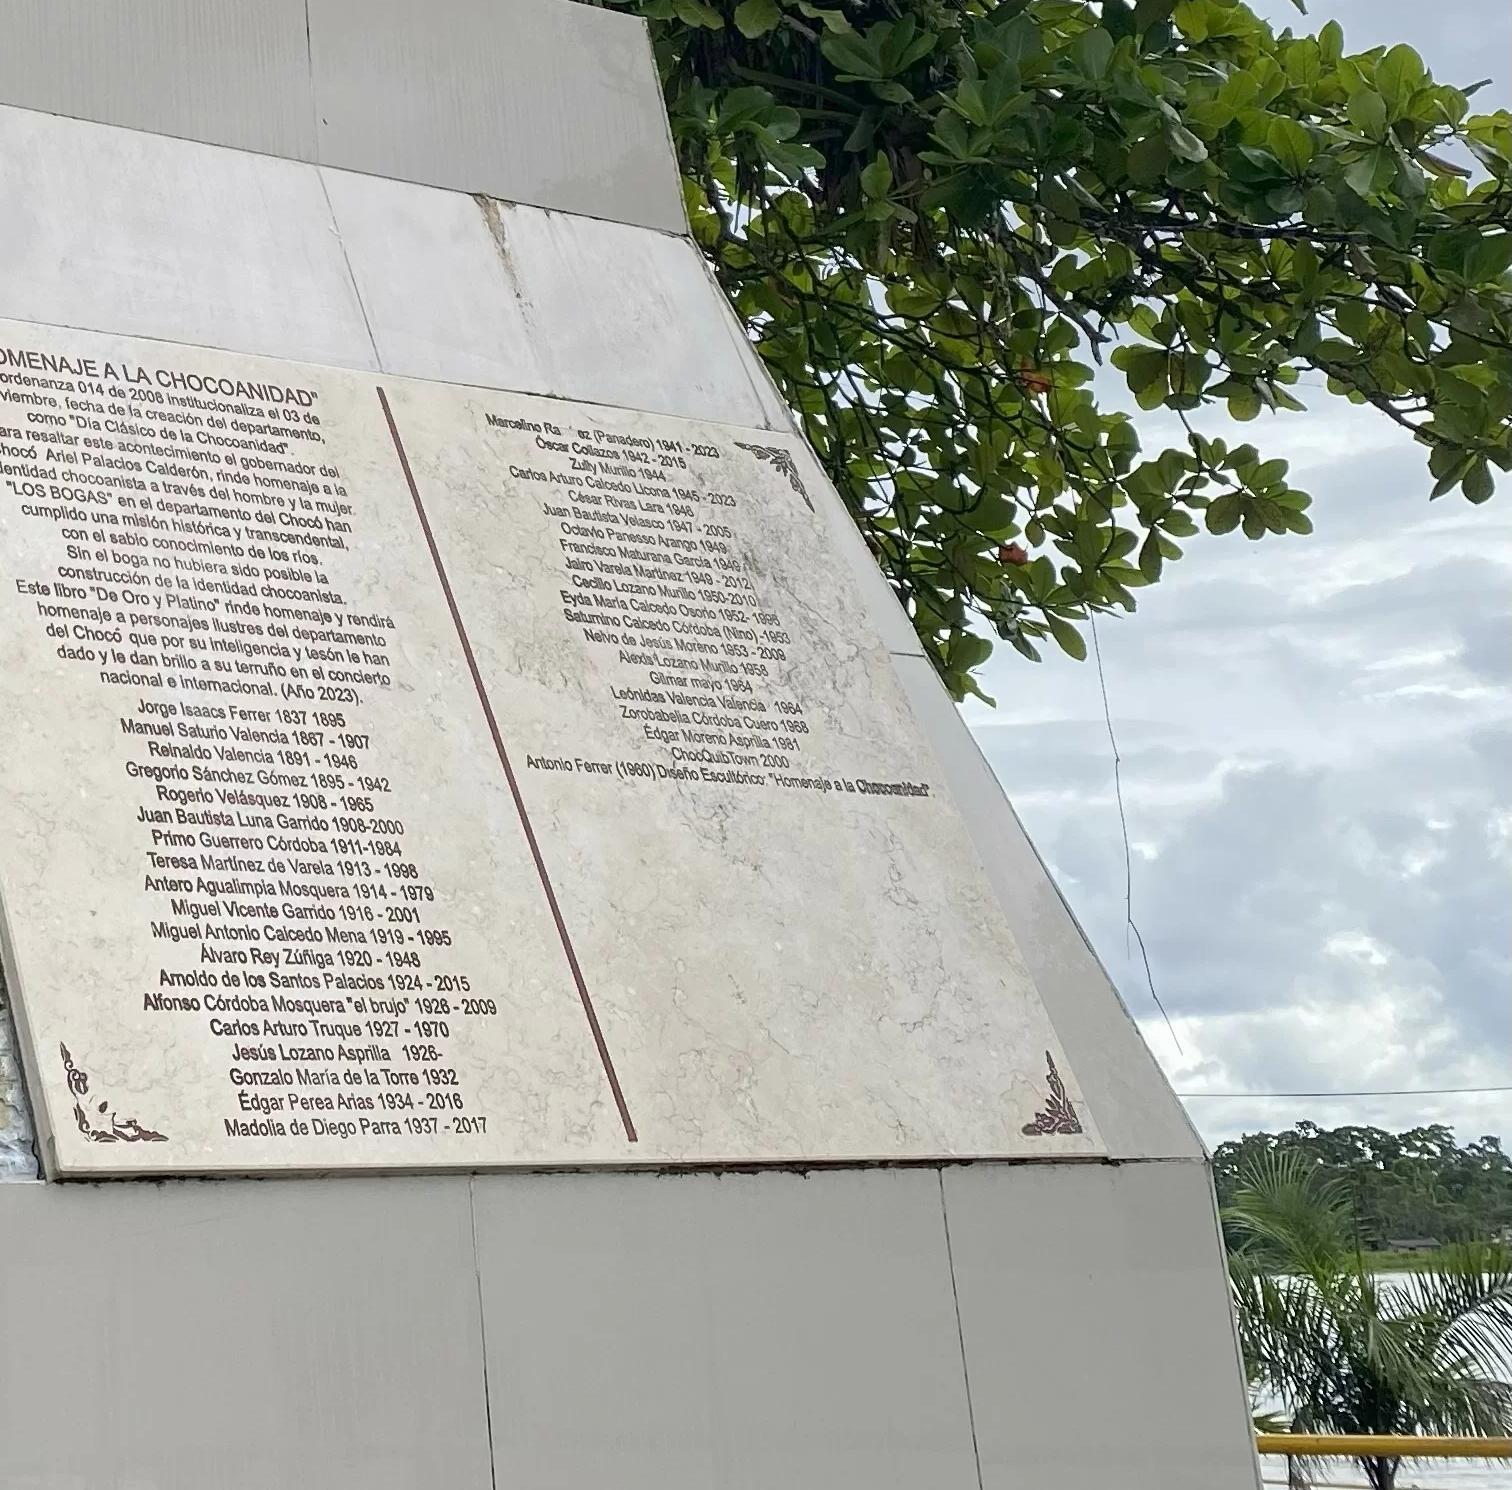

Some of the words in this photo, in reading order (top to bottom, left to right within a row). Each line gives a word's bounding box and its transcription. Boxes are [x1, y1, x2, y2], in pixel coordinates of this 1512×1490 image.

[103, 361, 121, 382] A
[121, 363, 153, 386] LA
[154, 369, 319, 408] CHOCOANIDAD"
[77, 380, 105, 397] 014
[107, 384, 127, 399] de
[127, 387, 165, 405] 2008
[165, 391, 266, 419] institucionaliza
[267, 406, 281, 421] el
[281, 408, 301, 423] 03
[302, 411, 321, 426] de
[64, 396, 106, 415] fecha
[107, 401, 126, 417] de
[125, 403, 143, 420] la
[144, 409, 204, 427] creación
[206, 414, 228, 430] del
[230, 418, 326, 445] departamento,
[25, 429, 80, 447] resaltar
[82, 436, 115, 451] este
[117, 439, 222, 465] acontecimiento
[223, 452, 238, 467] el
[239, 455, 317, 476] gobernador
[318, 463, 341, 479] del
[45, 447, 79, 465] Ariel
[80, 451, 143, 473] Palacios
[145, 459, 214, 483] Calderón,
[215, 468, 251, 486] rinde
[252, 472, 321, 497] homenaje
[322, 484, 333, 496] a
[333, 482, 349, 498] la
[5, 479, 47, 499] "LOS
[48, 484, 113, 505] BOGAS"
[117, 496, 137, 509] en
[139, 496, 154, 511] el
[156, 497, 252, 522] departamento
[254, 509, 277, 525] del
[278, 511, 324, 531] Chocó
[323, 516, 353, 534] han
[20, 504, 88, 523] cumplido
[90, 511, 120, 526] una
[121, 512, 171, 532] misión
[170, 517, 232, 538] histórica
[232, 527, 242, 542] y
[244, 525, 350, 552] transcendental,
[57, 565, 152, 587] construcción
[154, 573, 173, 589] de
[175, 574, 191, 591] la
[191, 576, 259, 598] identidad
[15, 578, 52, 597] Este
[52, 581, 88, 600] libro
[88, 585, 119, 603] "De
[121, 589, 151, 606] Oro
[152, 594, 162, 611] y
[164, 591, 221, 612] Platino"
[224, 599, 261, 617] rinde
[262, 602, 333, 626] homenaje
[333, 612, 344, 628] y
[346, 613, 397, 630] rendirá
[36, 600, 112, 625] homenaje
[115, 611, 127, 624] a
[128, 612, 210, 633] personajes
[211, 616, 265, 636] ilustres
[266, 622, 290, 639] del
[291, 625, 387, 648] departamento
[99, 669, 164, 688] nacional
[166, 676, 178, 689] e
[280, 682, 316, 702] (Año
[137, 698, 178, 719] Jorge
[179, 701, 227, 720] Isaacs
[228, 704, 271, 724] Ferrer
[274, 708, 307, 726] 1837
[311, 711, 347, 729] 1895
[147, 740, 213, 761] Reinaldo
[212, 744, 275, 765] Valencia
[276, 749, 311, 767] 1891
[125, 760, 190, 783] Gregorio
[191, 764, 256, 785] Sánchez
[256, 768, 309, 788] Gómez
[309, 772, 346, 790] 1895
[356, 775, 393, 793] 1942
[136, 805, 174, 824] Juan
[174, 807, 236, 827] Bautista
[235, 810, 275, 829] Luna
[275, 812, 330, 832] Garrido
[331, 815, 405, 836] 1908-2000
[198, 831, 264, 851] Guerrero
[266, 834, 329, 854] Córdoba
[329, 837, 403, 858] 1911-1984
[209, 1017, 261, 1037] Carlos
[262, 1018, 309, 1037] Arturo
[307, 1019, 363, 1042] Truque
[364, 1019, 400, 1038] 1927
[413, 1020, 450, 1039] 1970
[231, 1042, 278, 1062] Jesús
[277, 1042, 335, 1062] Lozano
[229, 1067, 294, 1087] Gonzalo
[295, 1067, 342, 1086] María
[342, 1067, 363, 1086] de
[363, 1067, 381, 1086] la
[379, 1068, 420, 1086] Torre
[421, 1067, 460, 1086] 1932
[223, 1117, 288, 1137] Madolia
[289, 1117, 310, 1136] de
[310, 1117, 357, 1140] Diego
[358, 1117, 403, 1136] Parra
[403, 1116, 438, 1135] 1937
[452, 1116, 487, 1134] 2017
